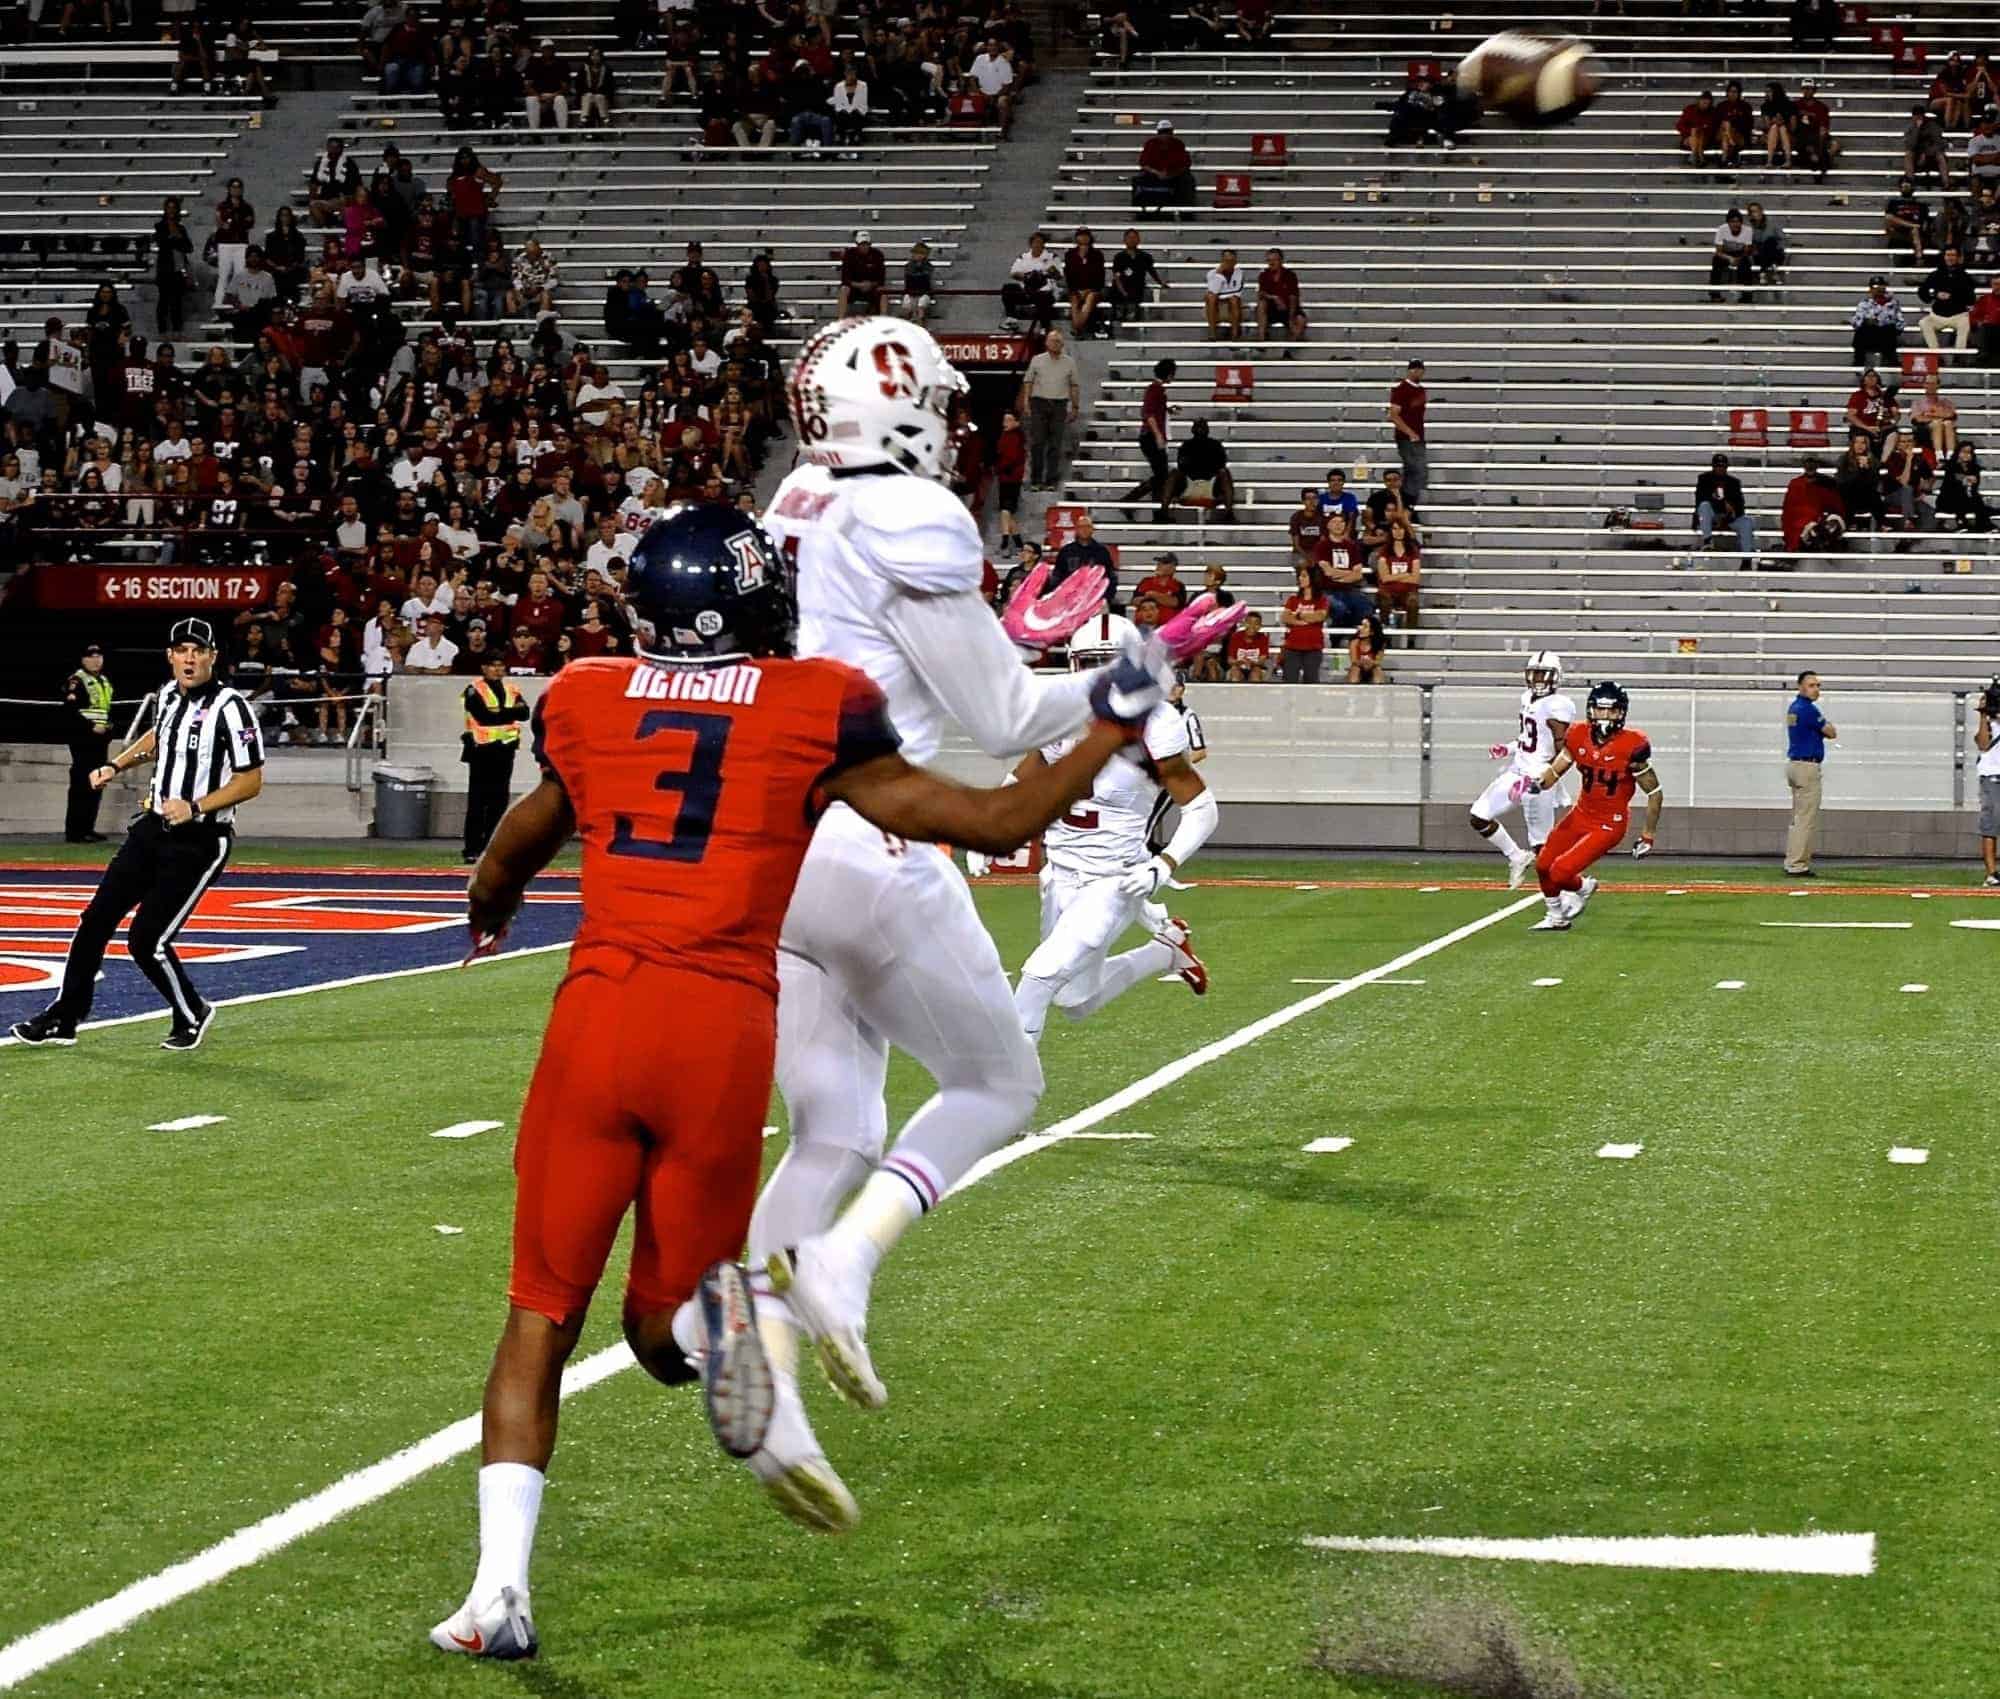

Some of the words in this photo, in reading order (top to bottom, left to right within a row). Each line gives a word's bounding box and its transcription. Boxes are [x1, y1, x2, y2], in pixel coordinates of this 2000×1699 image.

[943, 344, 981, 360] CTION
[984, 344, 999, 360] 18
[625, 512, 653, 532] 64
[723, 529, 770, 596] A
[122, 577, 142, 599] 16
[146, 577, 220, 599] SECTION
[224, 577, 243, 599] 17
[188, 734, 199, 750] B
[607, 709, 735, 864] 3
